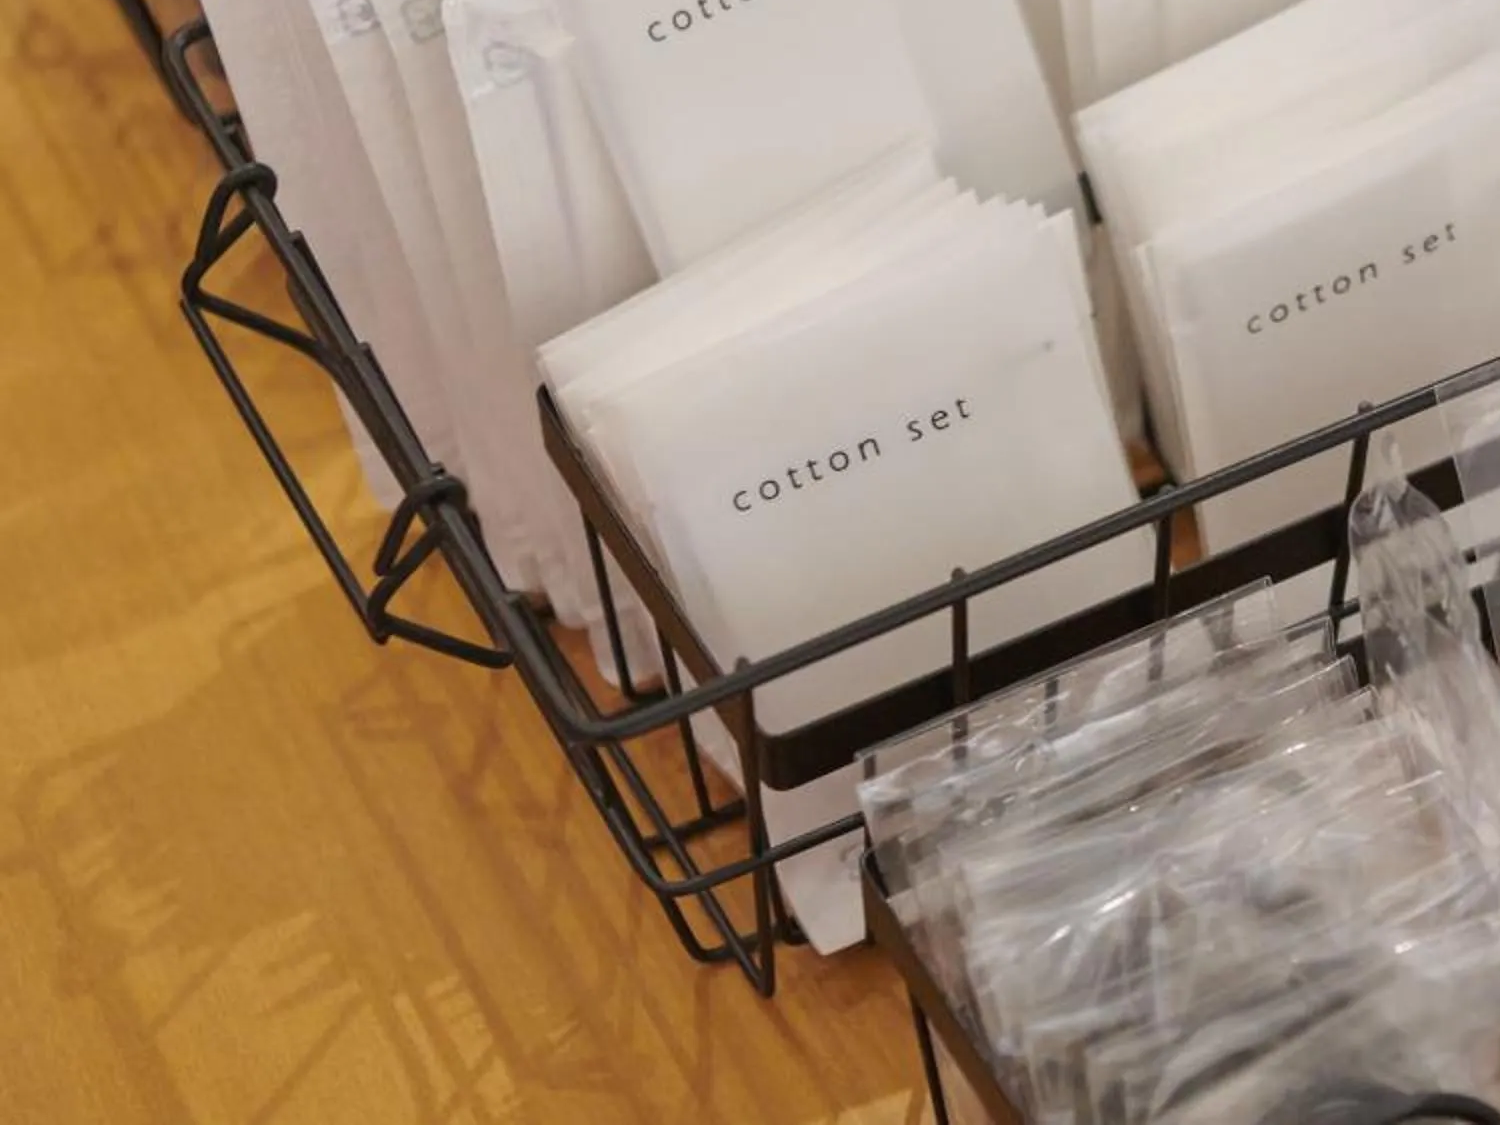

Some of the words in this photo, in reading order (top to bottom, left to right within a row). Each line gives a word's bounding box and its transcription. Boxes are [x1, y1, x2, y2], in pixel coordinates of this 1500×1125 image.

[1245, 261, 1379, 335] cotton
[1401, 220, 1457, 266] set
[731, 436, 882, 513] cotton
[905, 397, 972, 443] set
